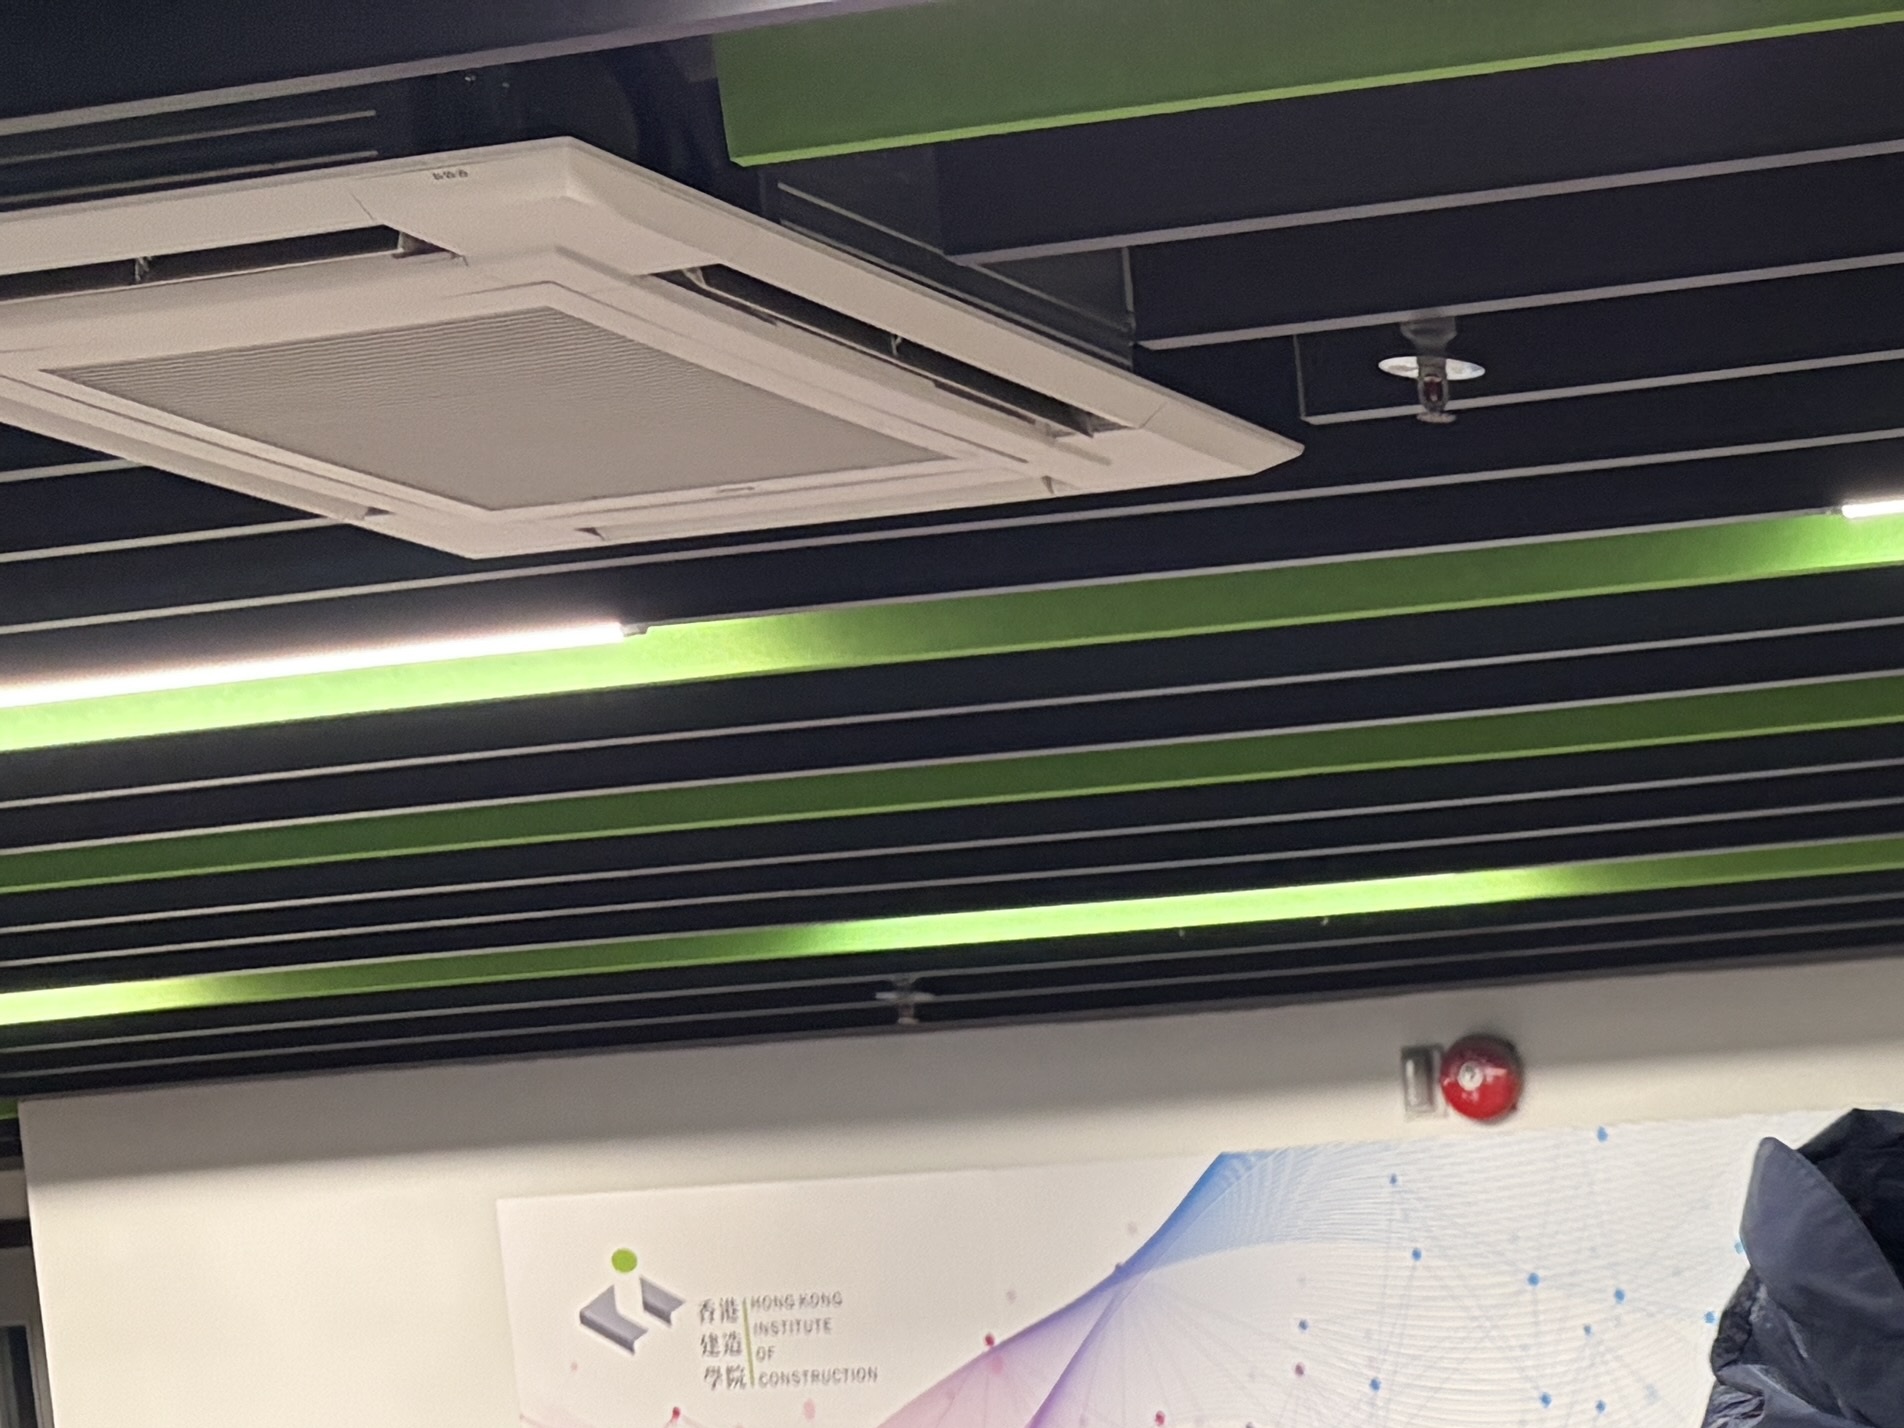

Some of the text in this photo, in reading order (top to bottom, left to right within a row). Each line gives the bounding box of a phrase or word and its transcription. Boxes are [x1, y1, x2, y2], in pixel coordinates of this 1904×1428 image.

[699, 1297, 741, 1325] 香港
[751, 1291, 843, 1311] HONG KONG
[753, 1317, 832, 1336] INSTITUTE
[756, 1345, 776, 1362] OF
[758, 1366, 878, 1388] CONSTRUCTION
